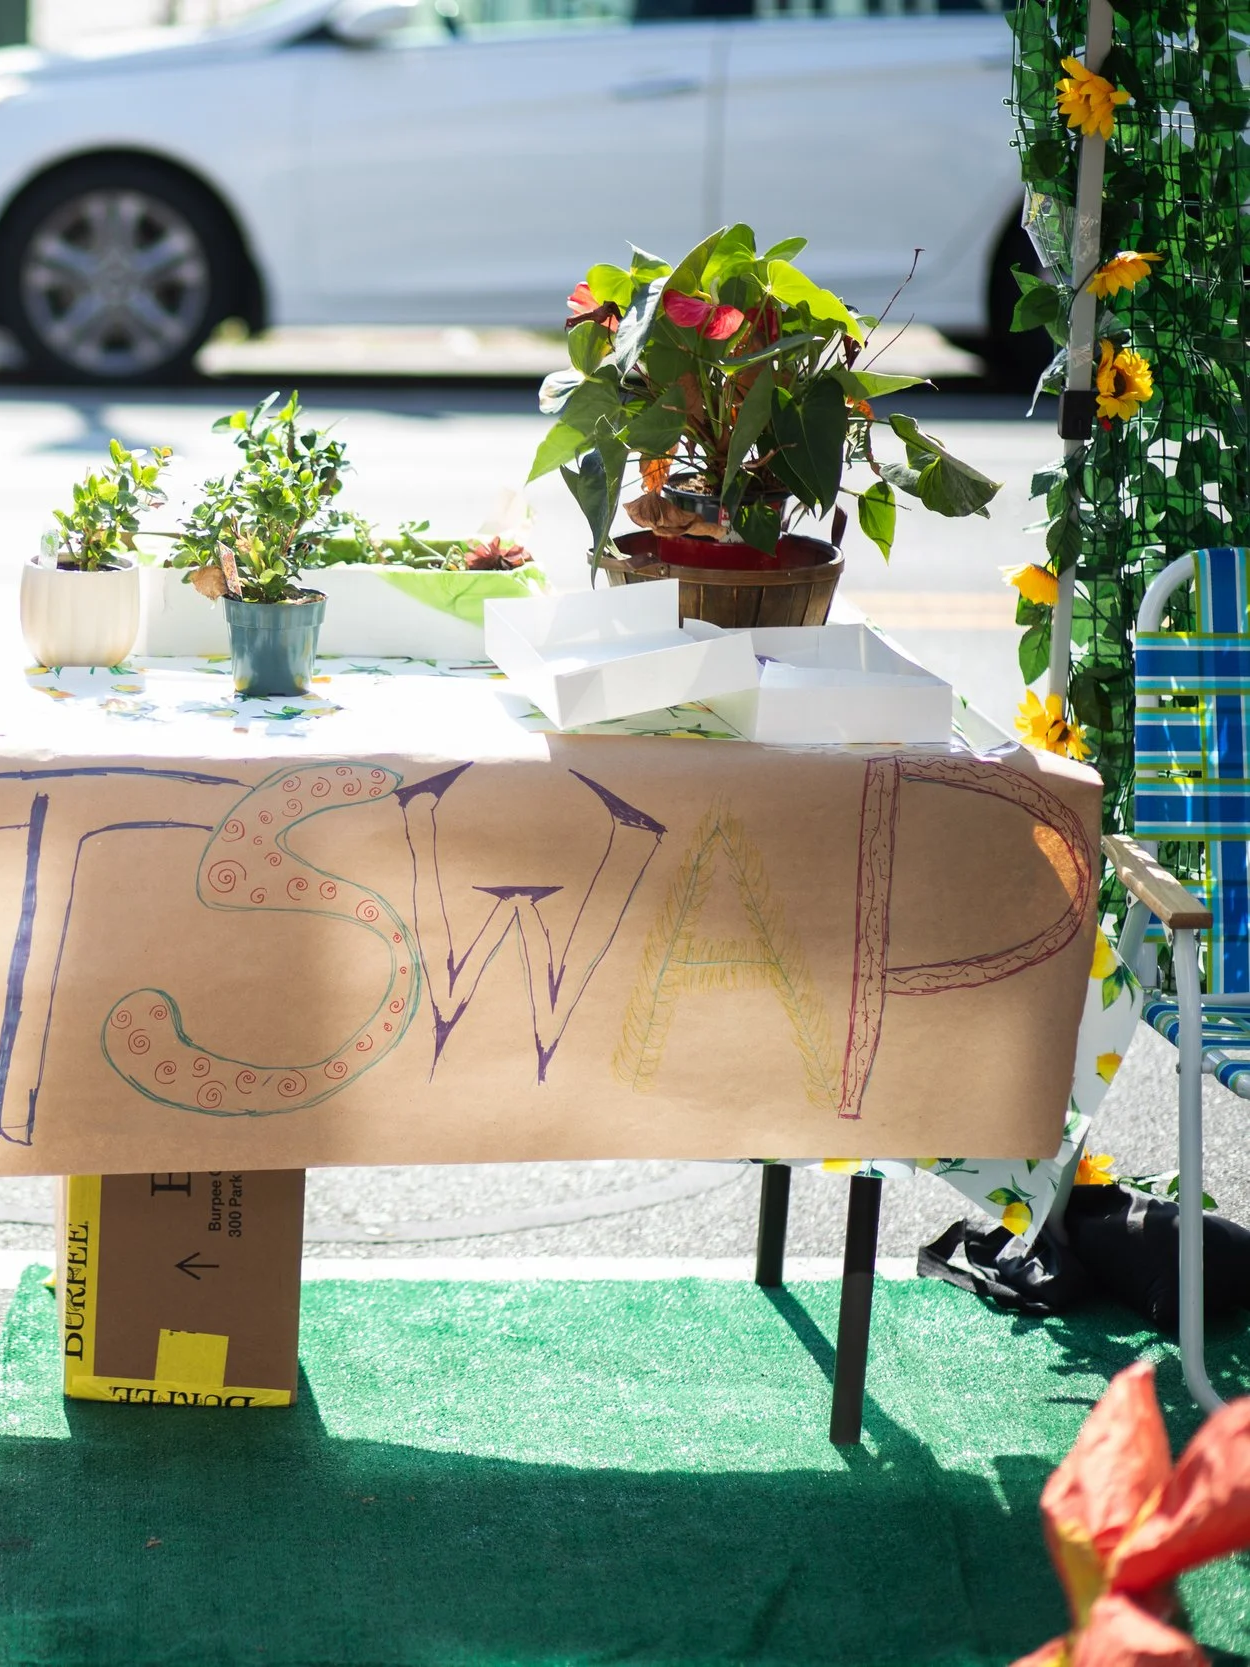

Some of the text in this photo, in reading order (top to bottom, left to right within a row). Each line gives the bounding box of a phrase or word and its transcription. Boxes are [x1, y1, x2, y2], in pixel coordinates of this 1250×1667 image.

[208, 1180, 225, 1232] Burpee
[228, 1175, 243, 1238] 300 Park
